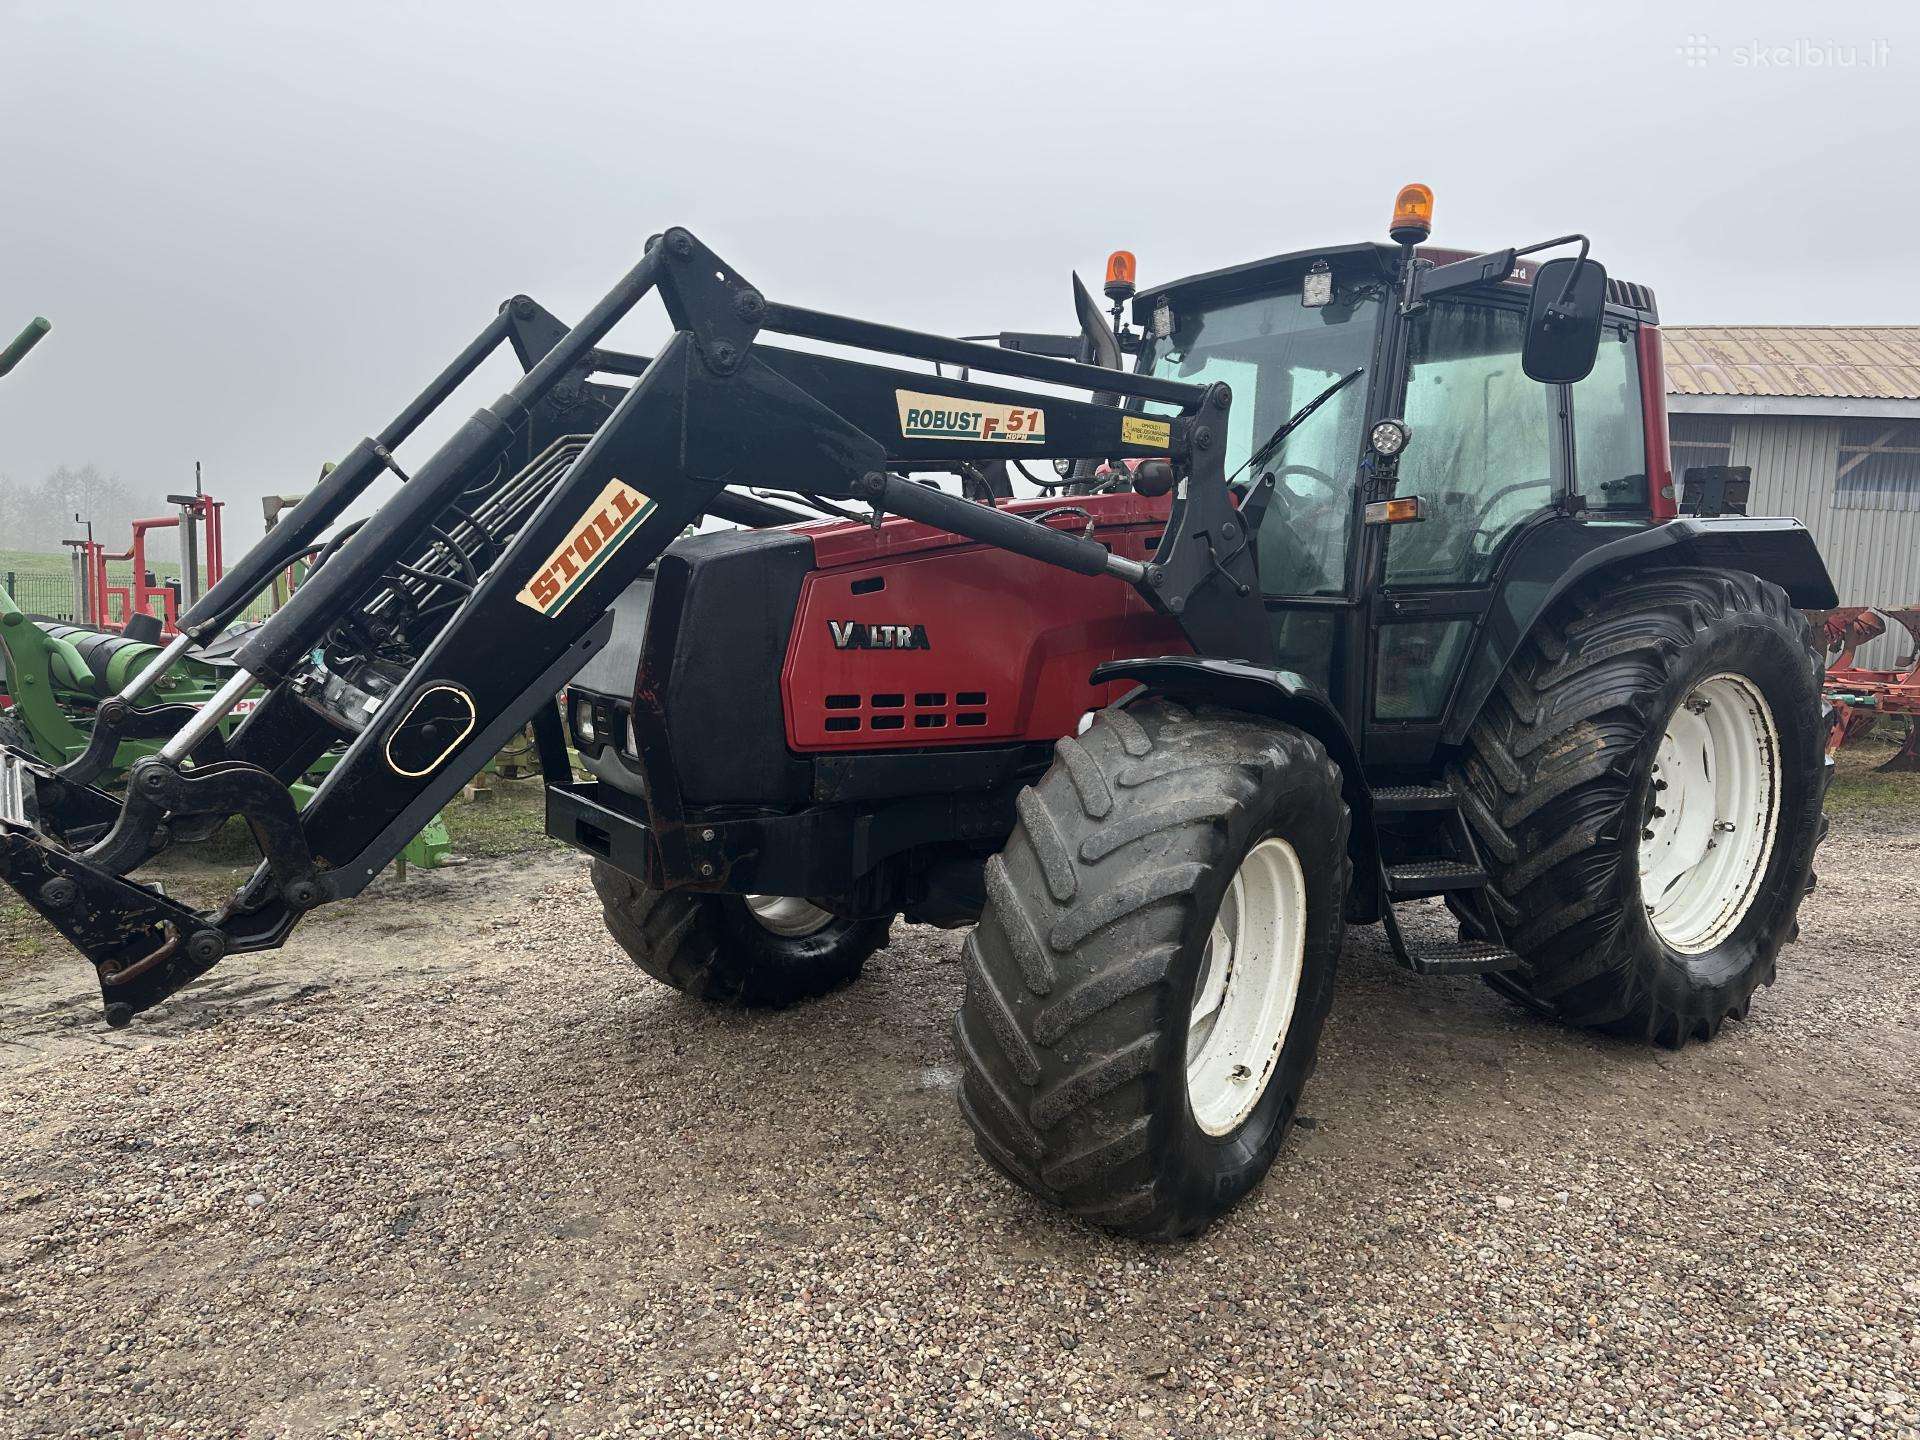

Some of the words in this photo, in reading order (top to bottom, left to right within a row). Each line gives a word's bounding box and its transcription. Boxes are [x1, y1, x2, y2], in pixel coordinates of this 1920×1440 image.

[906, 408, 983, 431] ROBUST
[982, 418, 999, 440] F
[1005, 409, 1039, 432] 51
[530, 488, 641, 609] STOLL
[827, 619, 931, 650] VALTRA
